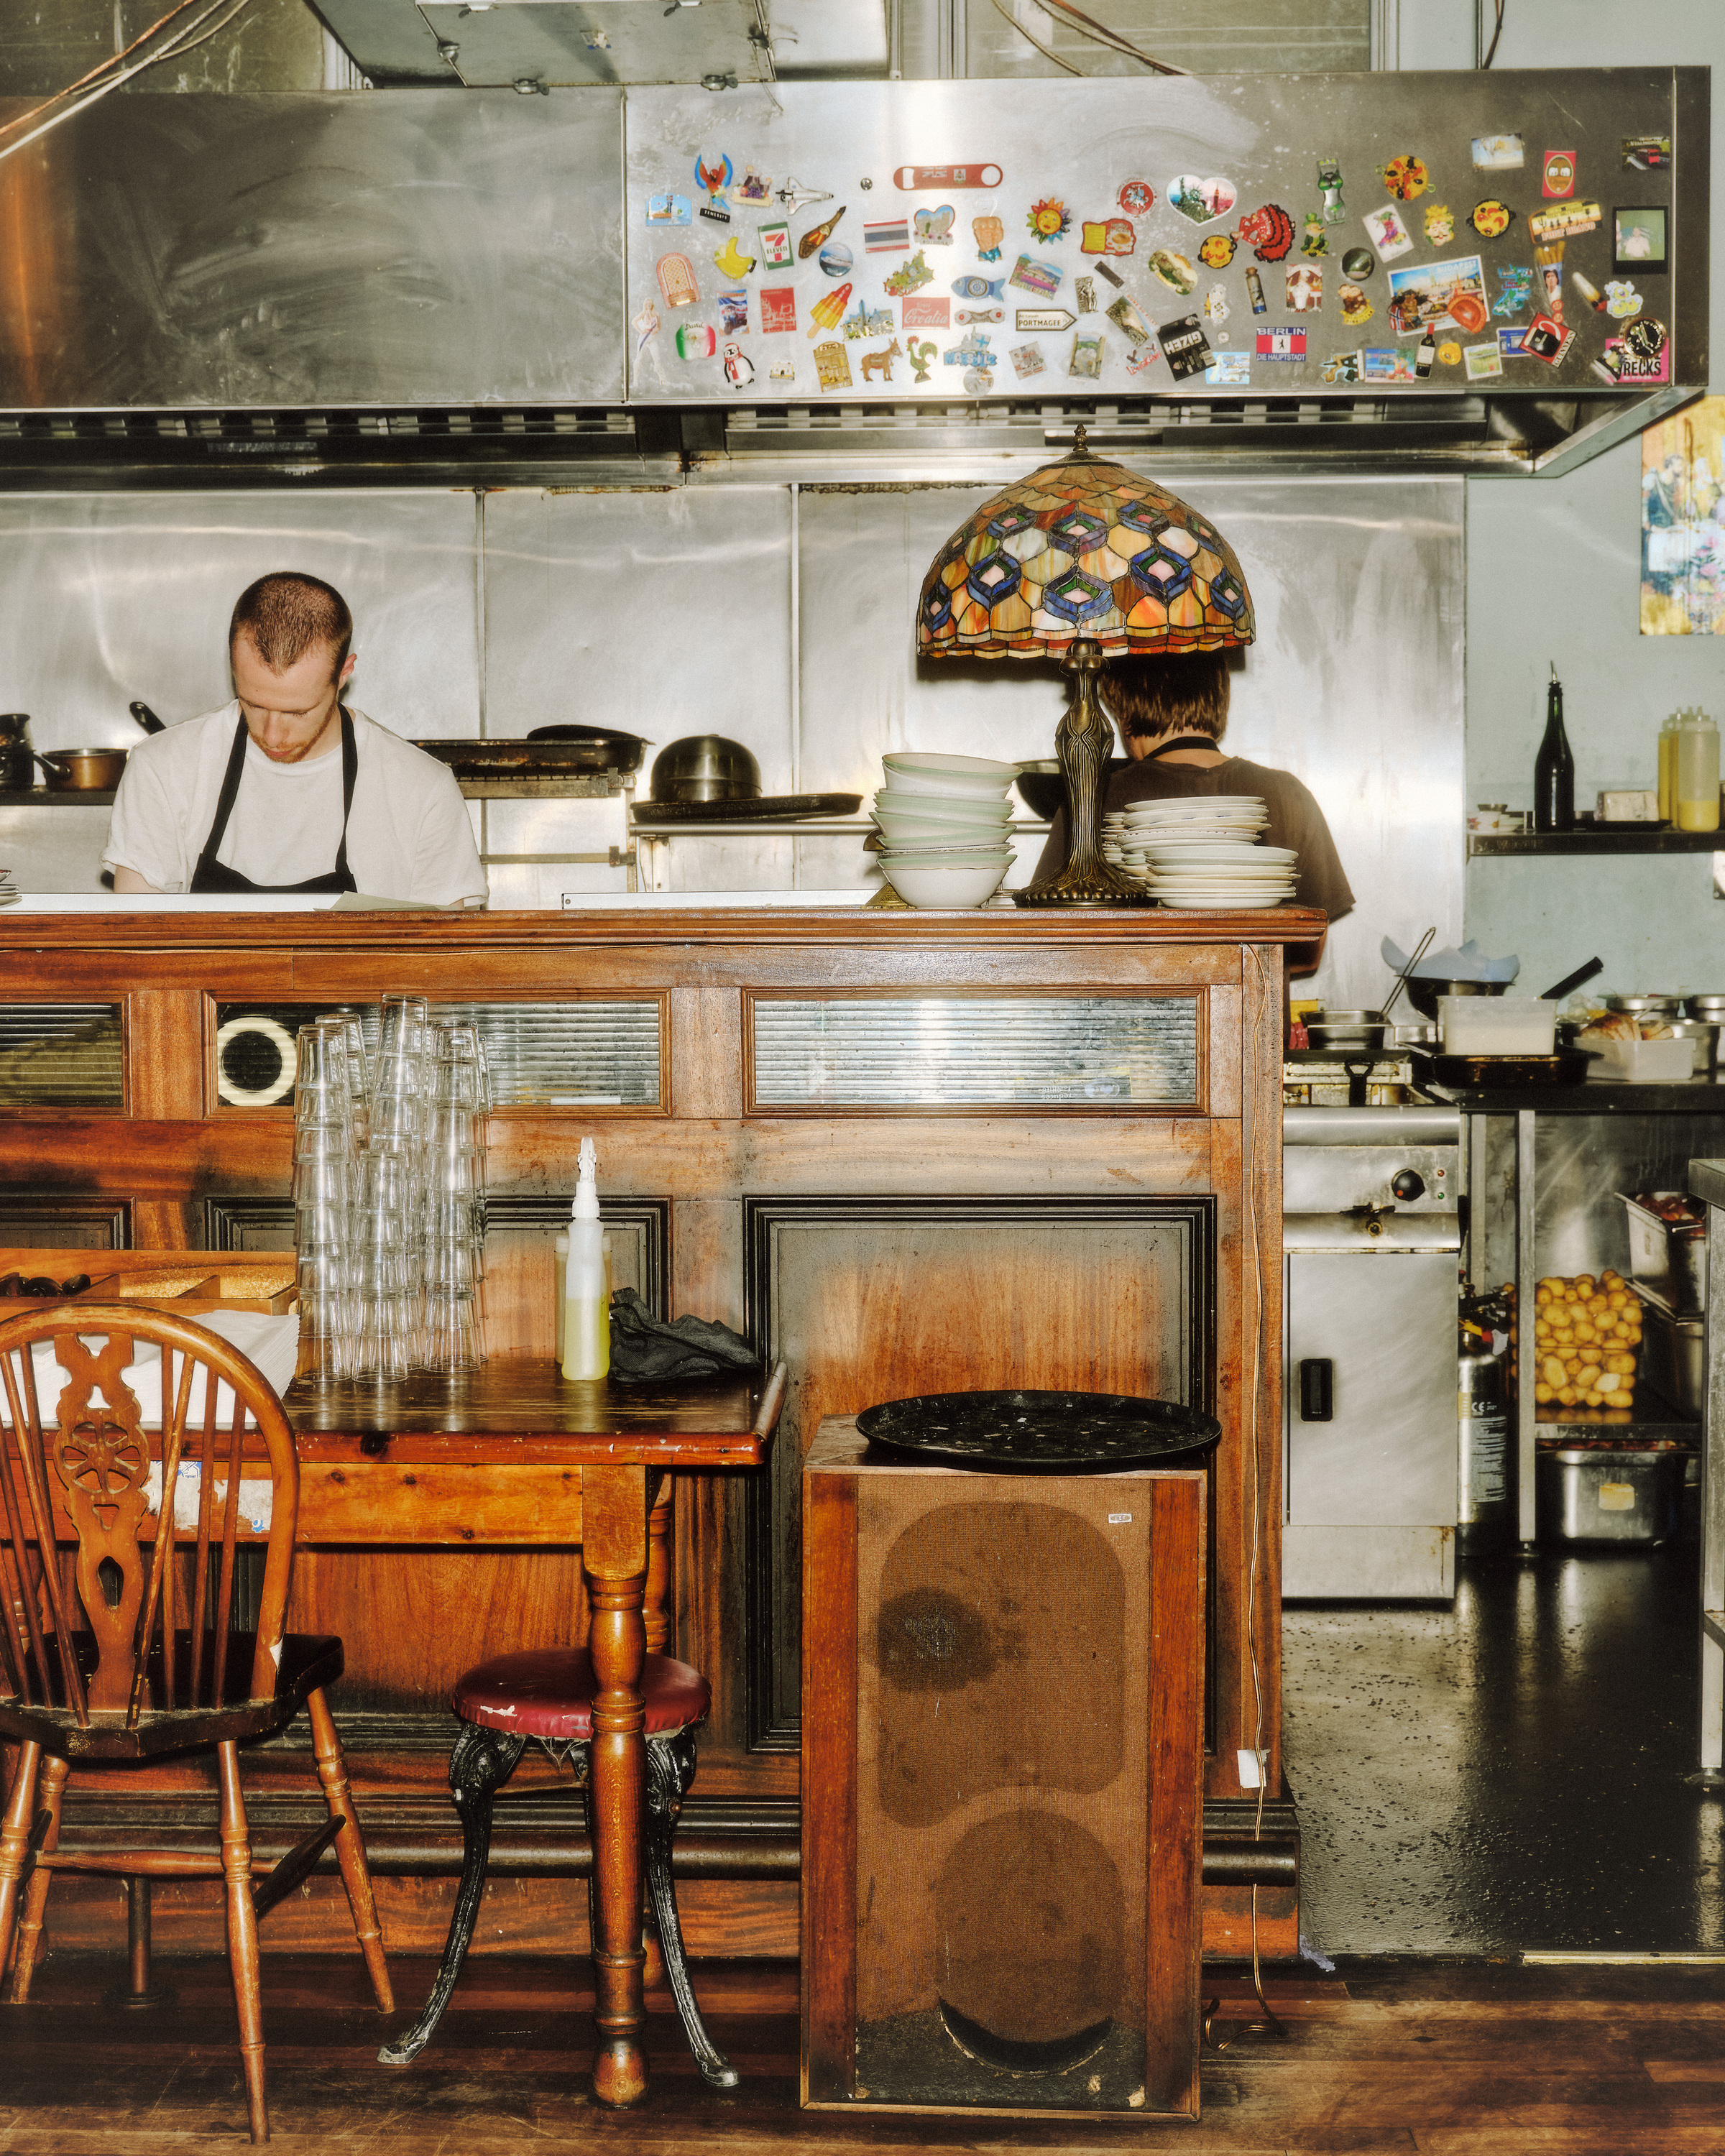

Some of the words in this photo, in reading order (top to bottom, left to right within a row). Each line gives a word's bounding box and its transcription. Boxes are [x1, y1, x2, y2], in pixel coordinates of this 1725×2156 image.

[840, 319, 895, 341] PARIS
[1258, 327, 1306, 336] BERLIN
[1163, 331, 1202, 355] GIZEH
[1555, 332, 1575, 365] GUINNESS
